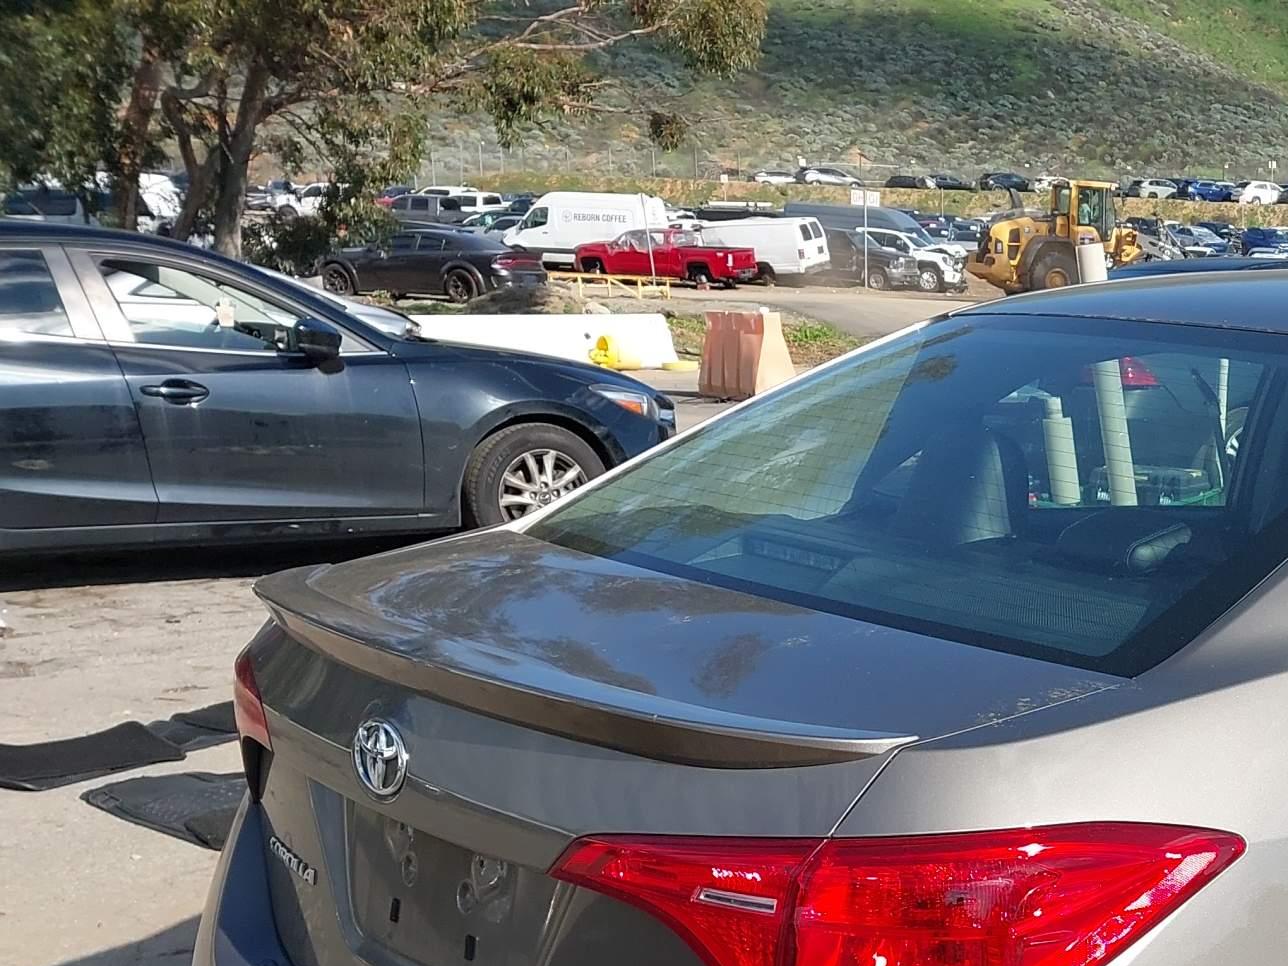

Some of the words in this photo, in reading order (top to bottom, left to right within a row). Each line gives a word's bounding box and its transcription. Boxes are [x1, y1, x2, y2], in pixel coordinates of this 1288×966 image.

[573, 213, 601, 222] REBORN
[601, 214, 627, 223] COFFEE
[269, 836, 315, 886] COROLLA
